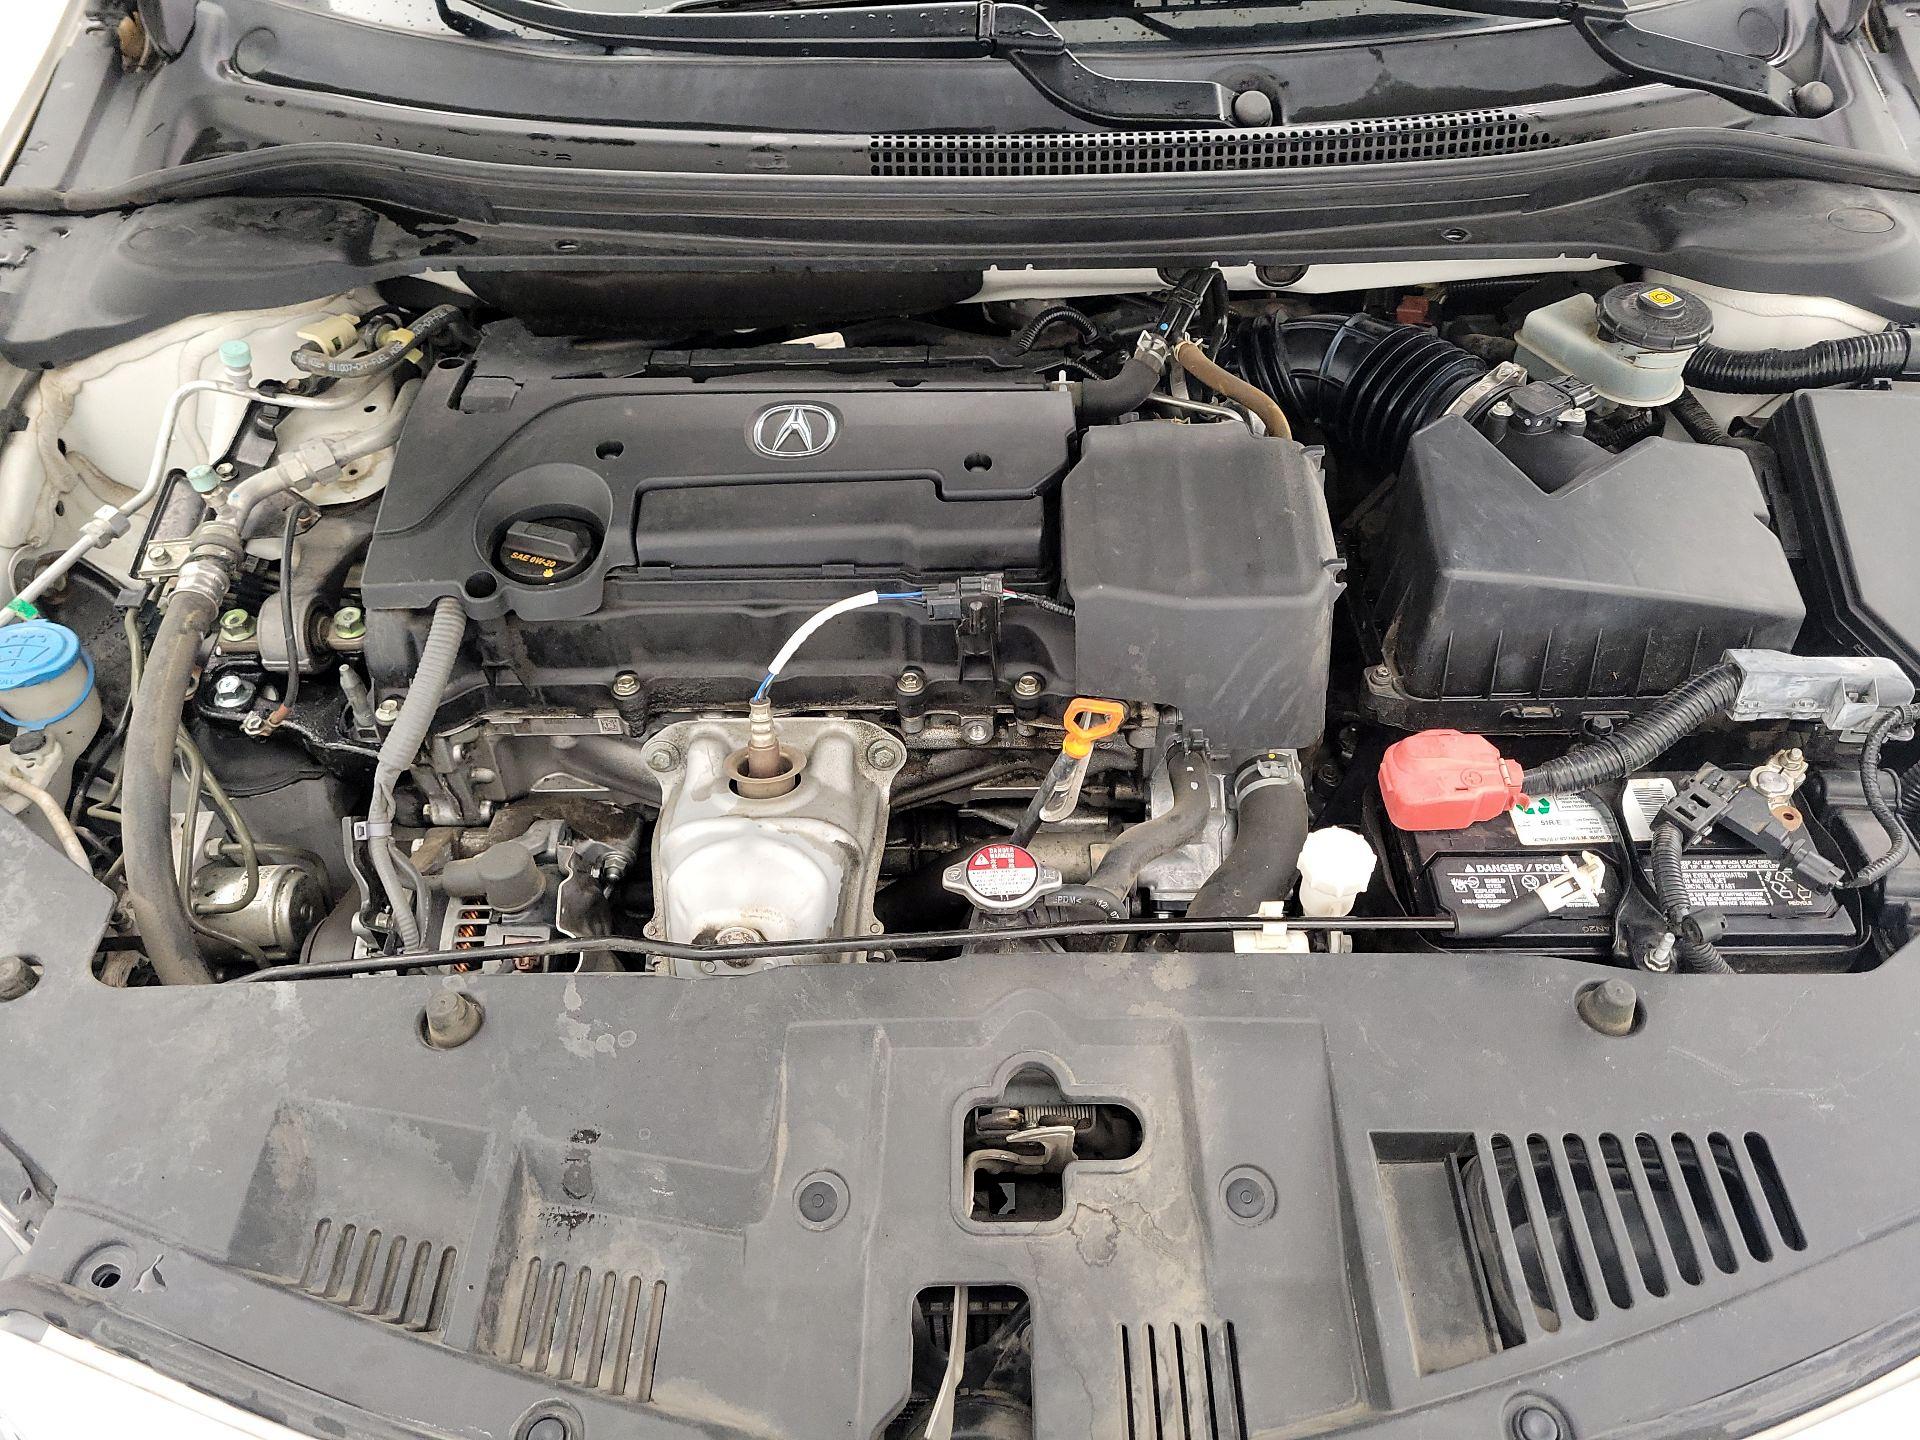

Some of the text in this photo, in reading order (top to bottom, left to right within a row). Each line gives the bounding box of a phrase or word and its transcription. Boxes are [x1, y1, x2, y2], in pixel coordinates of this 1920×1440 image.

[511, 552, 557, 568] SAE 0W-20
[1476, 864, 1524, 873] DANGER
[1535, 863, 1571, 872] POISO
